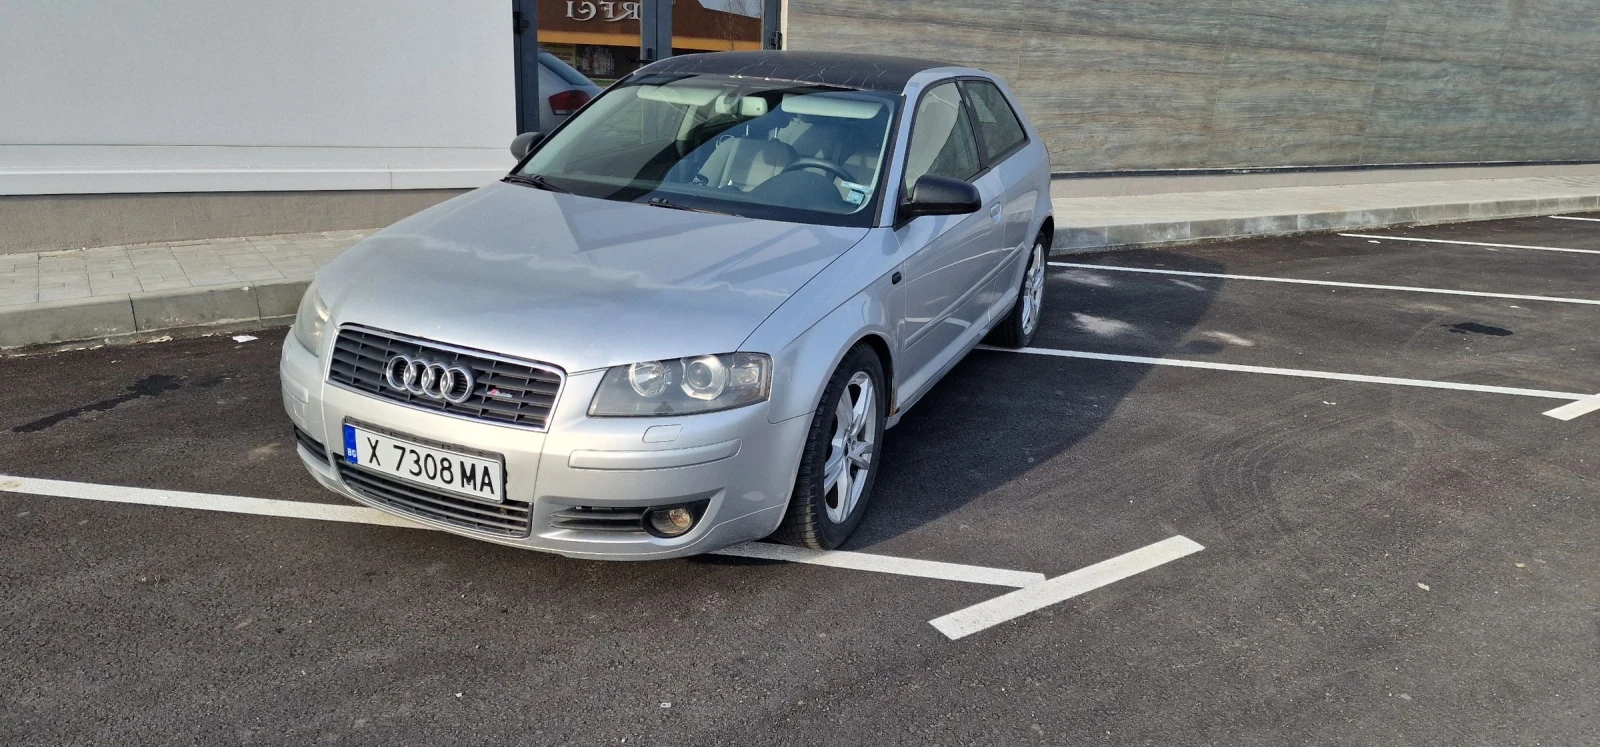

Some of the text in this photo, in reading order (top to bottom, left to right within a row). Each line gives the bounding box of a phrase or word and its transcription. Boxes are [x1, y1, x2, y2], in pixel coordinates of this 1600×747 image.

[347, 447, 357, 458] BG
[367, 437, 495, 494] X 7308 MA
